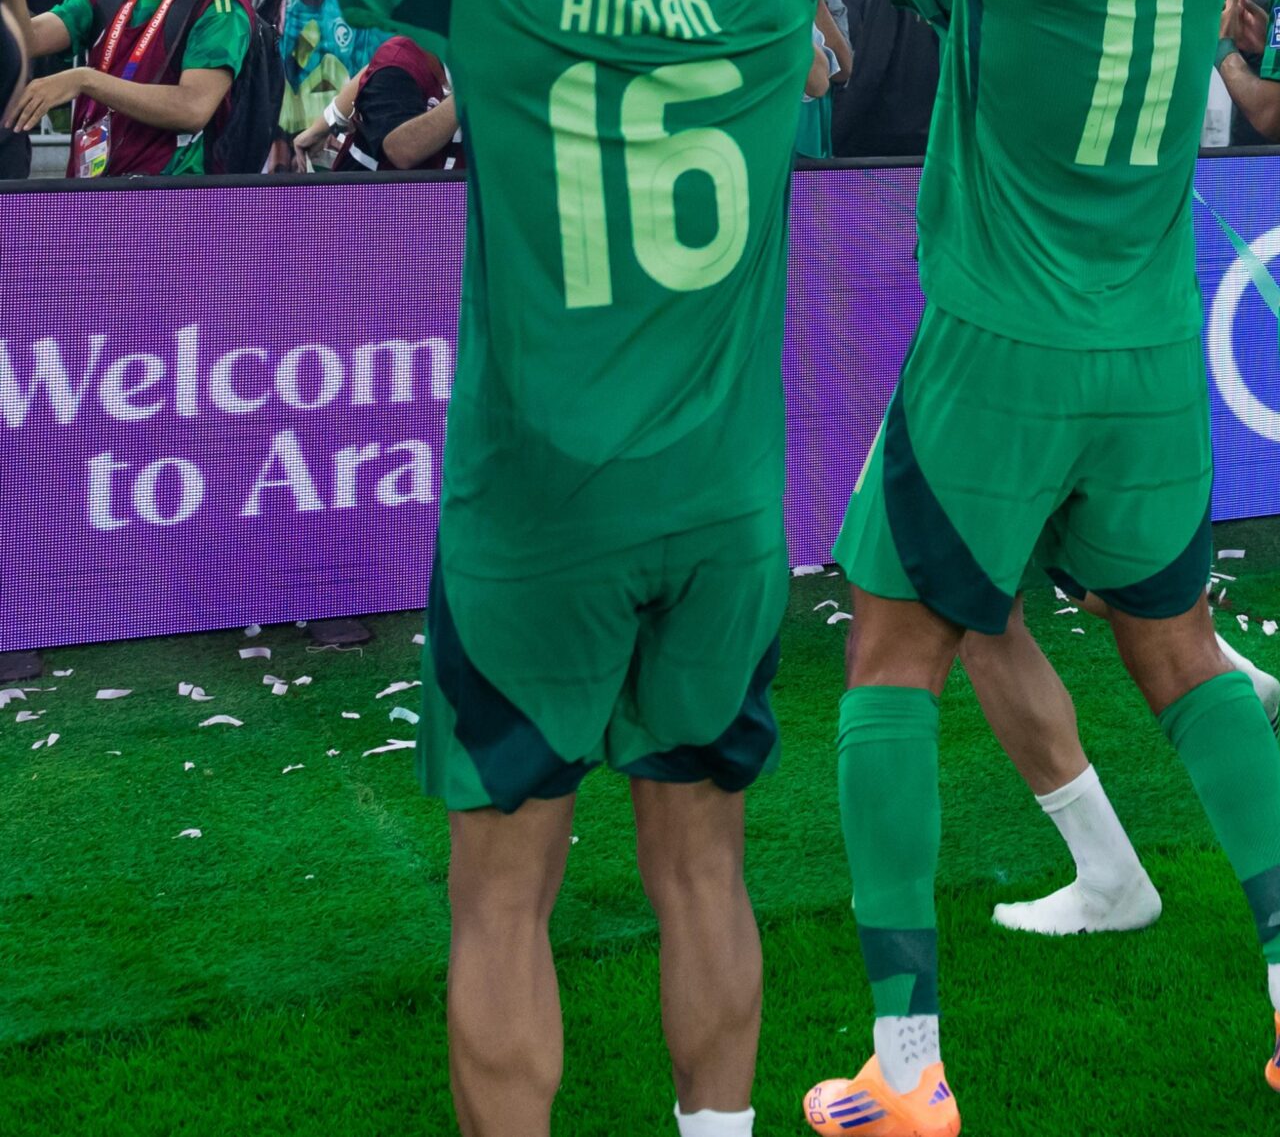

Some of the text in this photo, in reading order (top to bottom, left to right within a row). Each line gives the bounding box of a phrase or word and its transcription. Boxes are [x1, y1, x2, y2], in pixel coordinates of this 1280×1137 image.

[549, 59, 749, 309] 16
[0, 323, 456, 429] Welcom
[87, 428, 434, 531] to Ara
